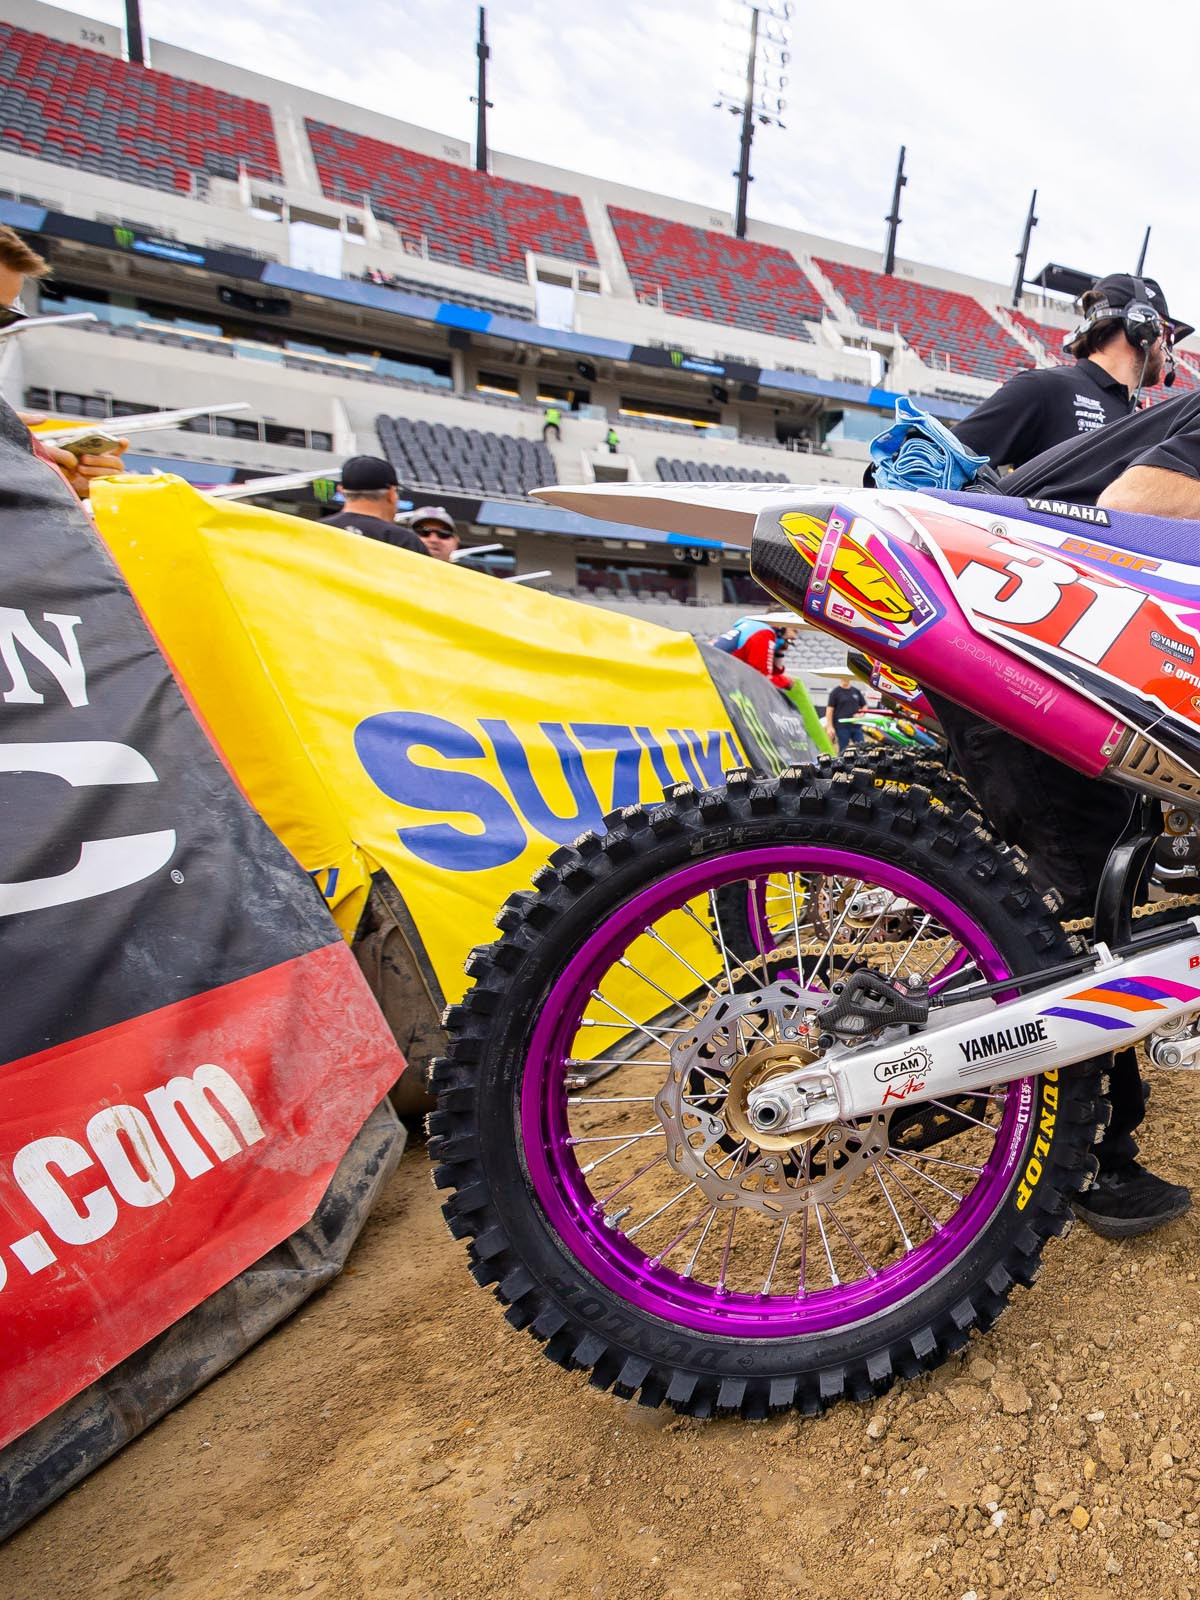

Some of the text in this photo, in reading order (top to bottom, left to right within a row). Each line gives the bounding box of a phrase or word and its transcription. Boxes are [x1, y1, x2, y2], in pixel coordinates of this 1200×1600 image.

[1026, 499, 1110, 524] YAMAHA
[777, 515, 916, 614] FMF
[1059, 537, 1163, 571] 250F
[911, 593, 931, 617] 4.1
[957, 541, 1151, 667] 31
[946, 635, 1003, 671] JORDAN
[1002, 665, 1046, 695] SMITH
[1160, 634, 1195, 658] YAMAHA
[353, 710, 744, 872] SUZUKI
[959, 1019, 1048, 1063] YAMALUBE
[883, 1057, 919, 1077] AFAM
[881, 1076, 927, 1106] Kite
[1016, 1068, 1060, 1211] DUNLOP
